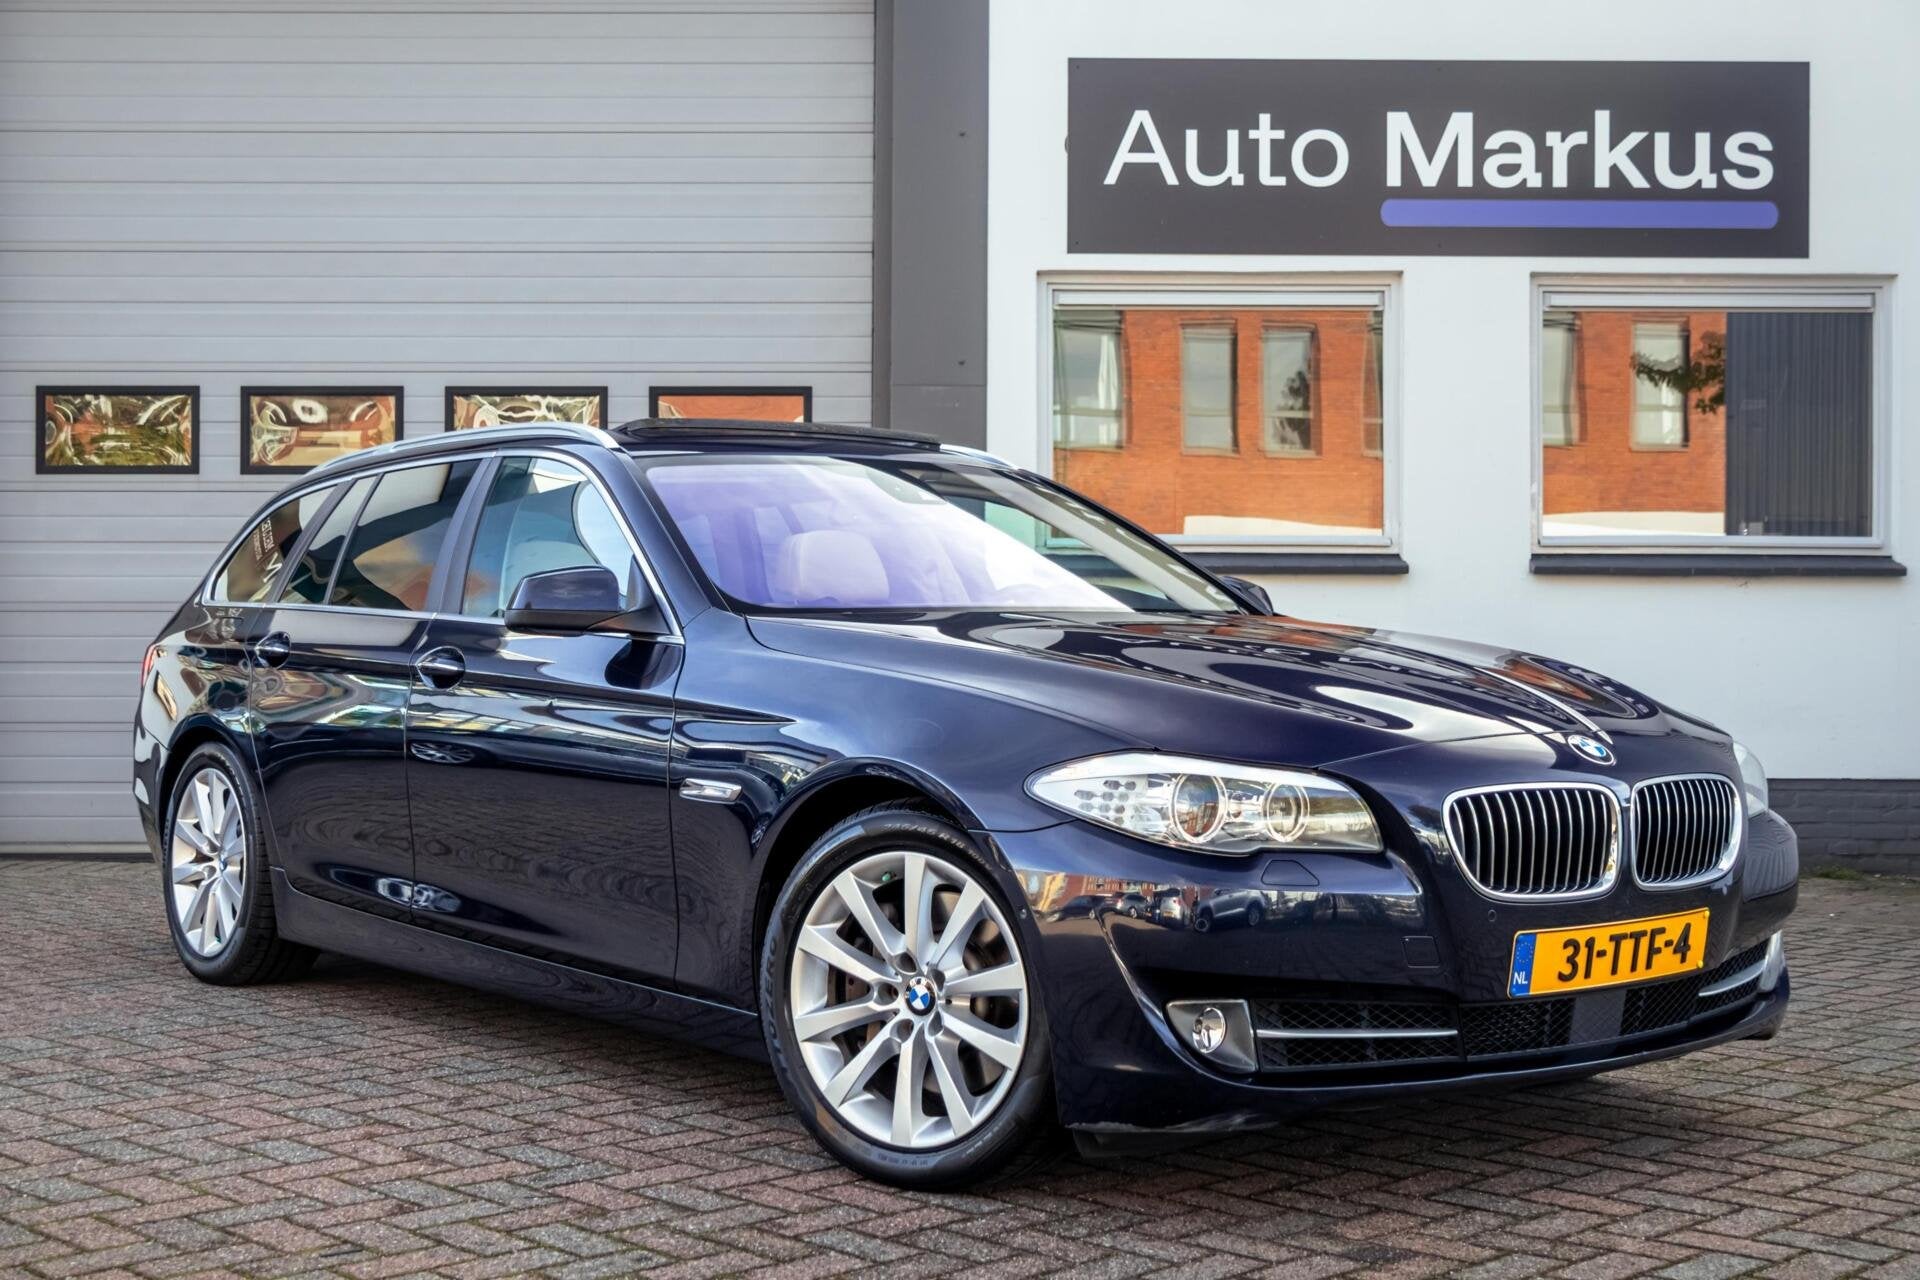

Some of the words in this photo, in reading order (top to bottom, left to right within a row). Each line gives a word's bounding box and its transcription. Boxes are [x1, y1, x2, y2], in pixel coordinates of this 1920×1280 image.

[1103, 109, 1350, 188] Auto
[1386, 110, 1774, 190] Markus
[1513, 970, 1529, 985] NL
[1558, 922, 1692, 983] 31-TTF-4
